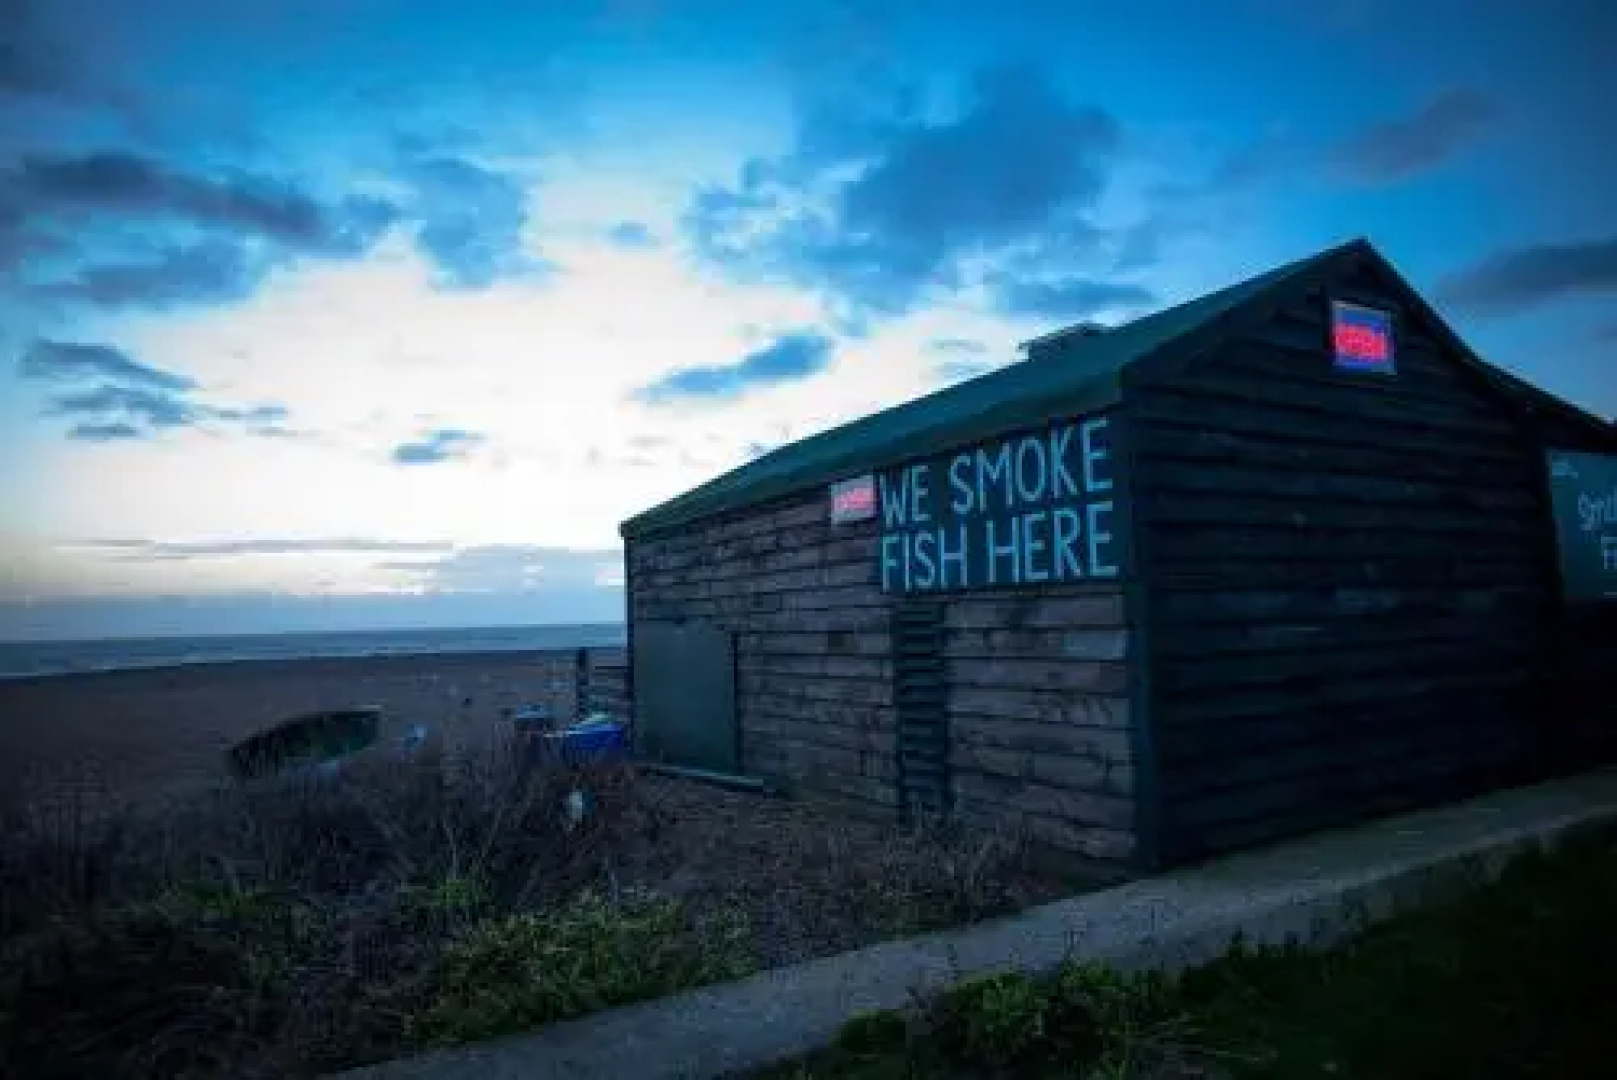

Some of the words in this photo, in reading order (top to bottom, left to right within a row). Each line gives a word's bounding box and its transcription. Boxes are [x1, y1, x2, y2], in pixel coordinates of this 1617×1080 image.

[879, 465, 929, 528] WE
[950, 417, 1113, 513] SMOKE
[881, 524, 968, 592] FISH
[987, 500, 1120, 584] HERE
